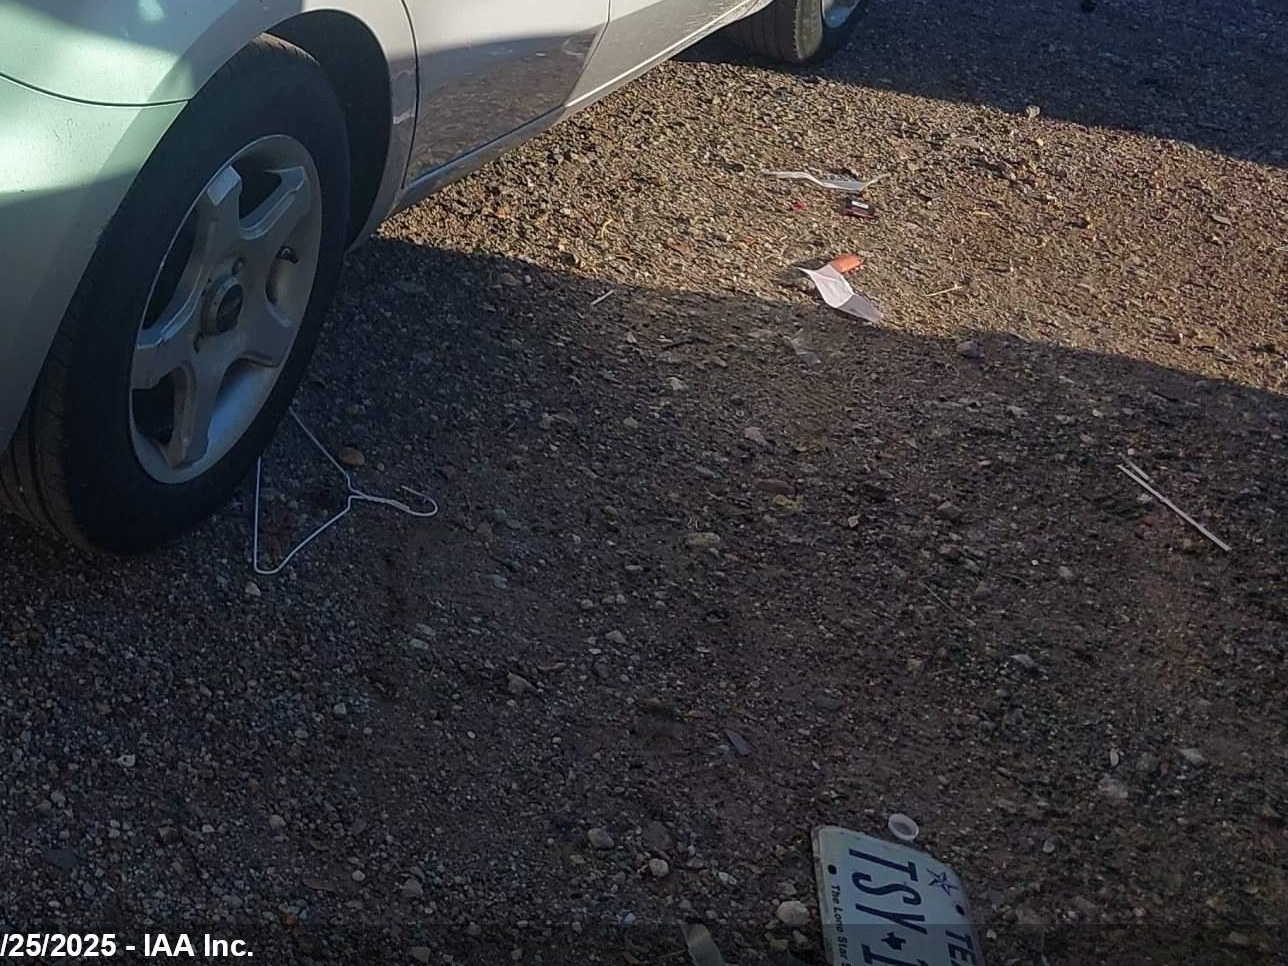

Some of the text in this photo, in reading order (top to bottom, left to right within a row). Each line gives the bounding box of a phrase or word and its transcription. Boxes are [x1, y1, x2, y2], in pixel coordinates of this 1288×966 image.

[831, 884, 841, 904] The
[848, 848, 928, 935] TSY
[833, 906, 844, 933] Lone
[838, 937, 848, 965] Star
[945, 930, 978, 966] TE
